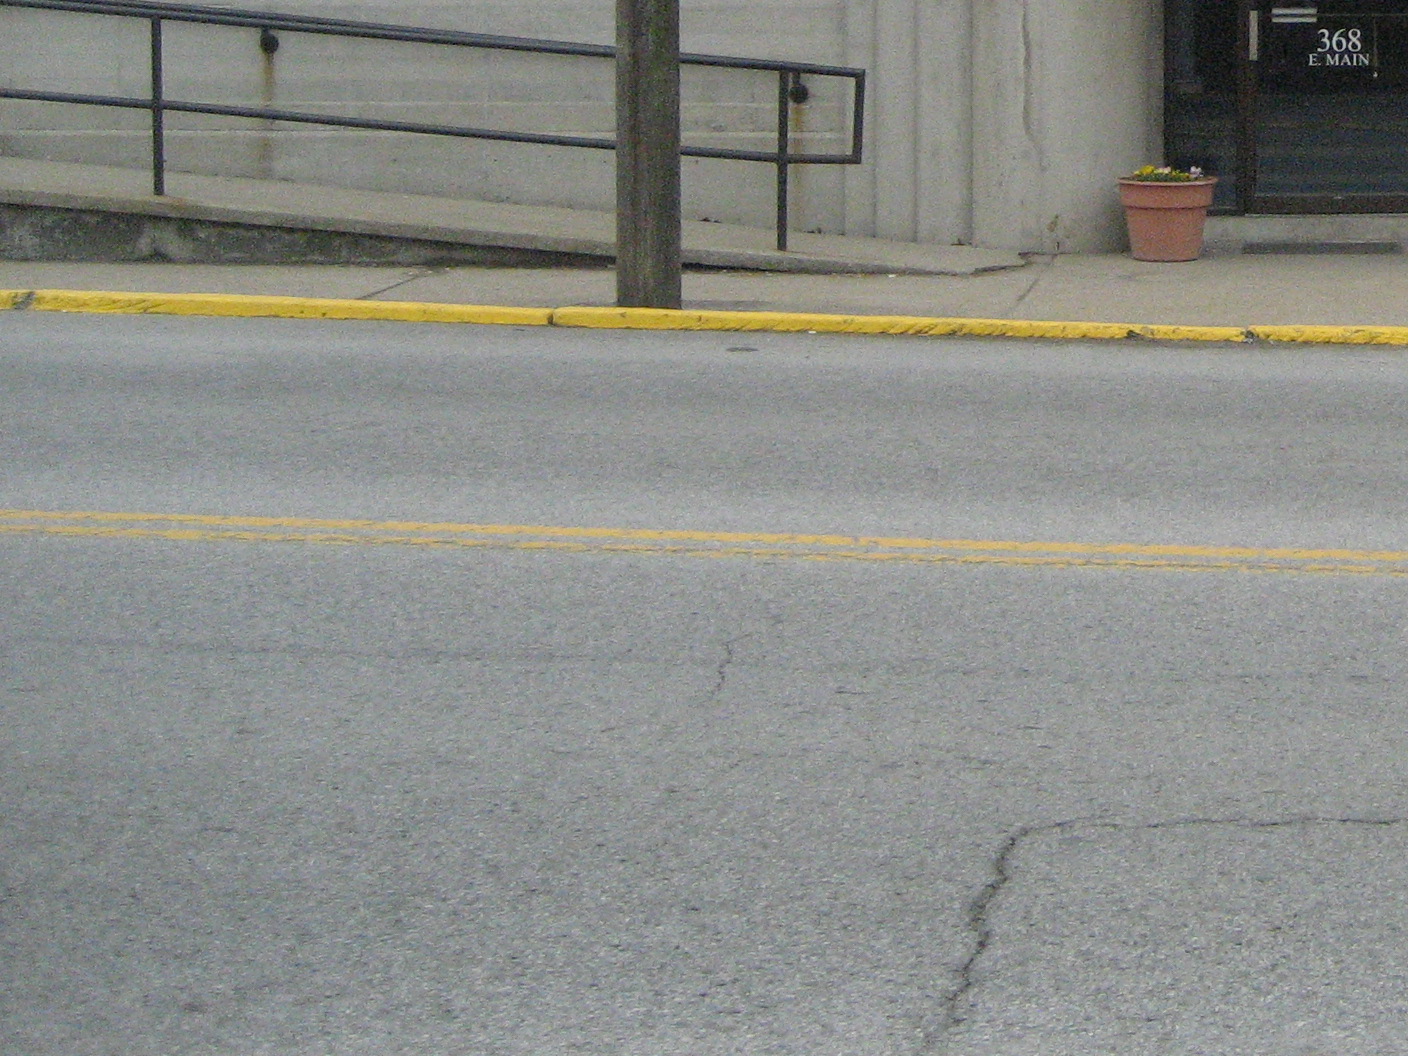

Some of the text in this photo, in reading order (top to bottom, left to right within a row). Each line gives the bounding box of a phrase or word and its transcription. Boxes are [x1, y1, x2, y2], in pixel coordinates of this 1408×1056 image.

[1317, 28, 1362, 52] 368
[1308, 53, 1370, 66] E. MAIN
